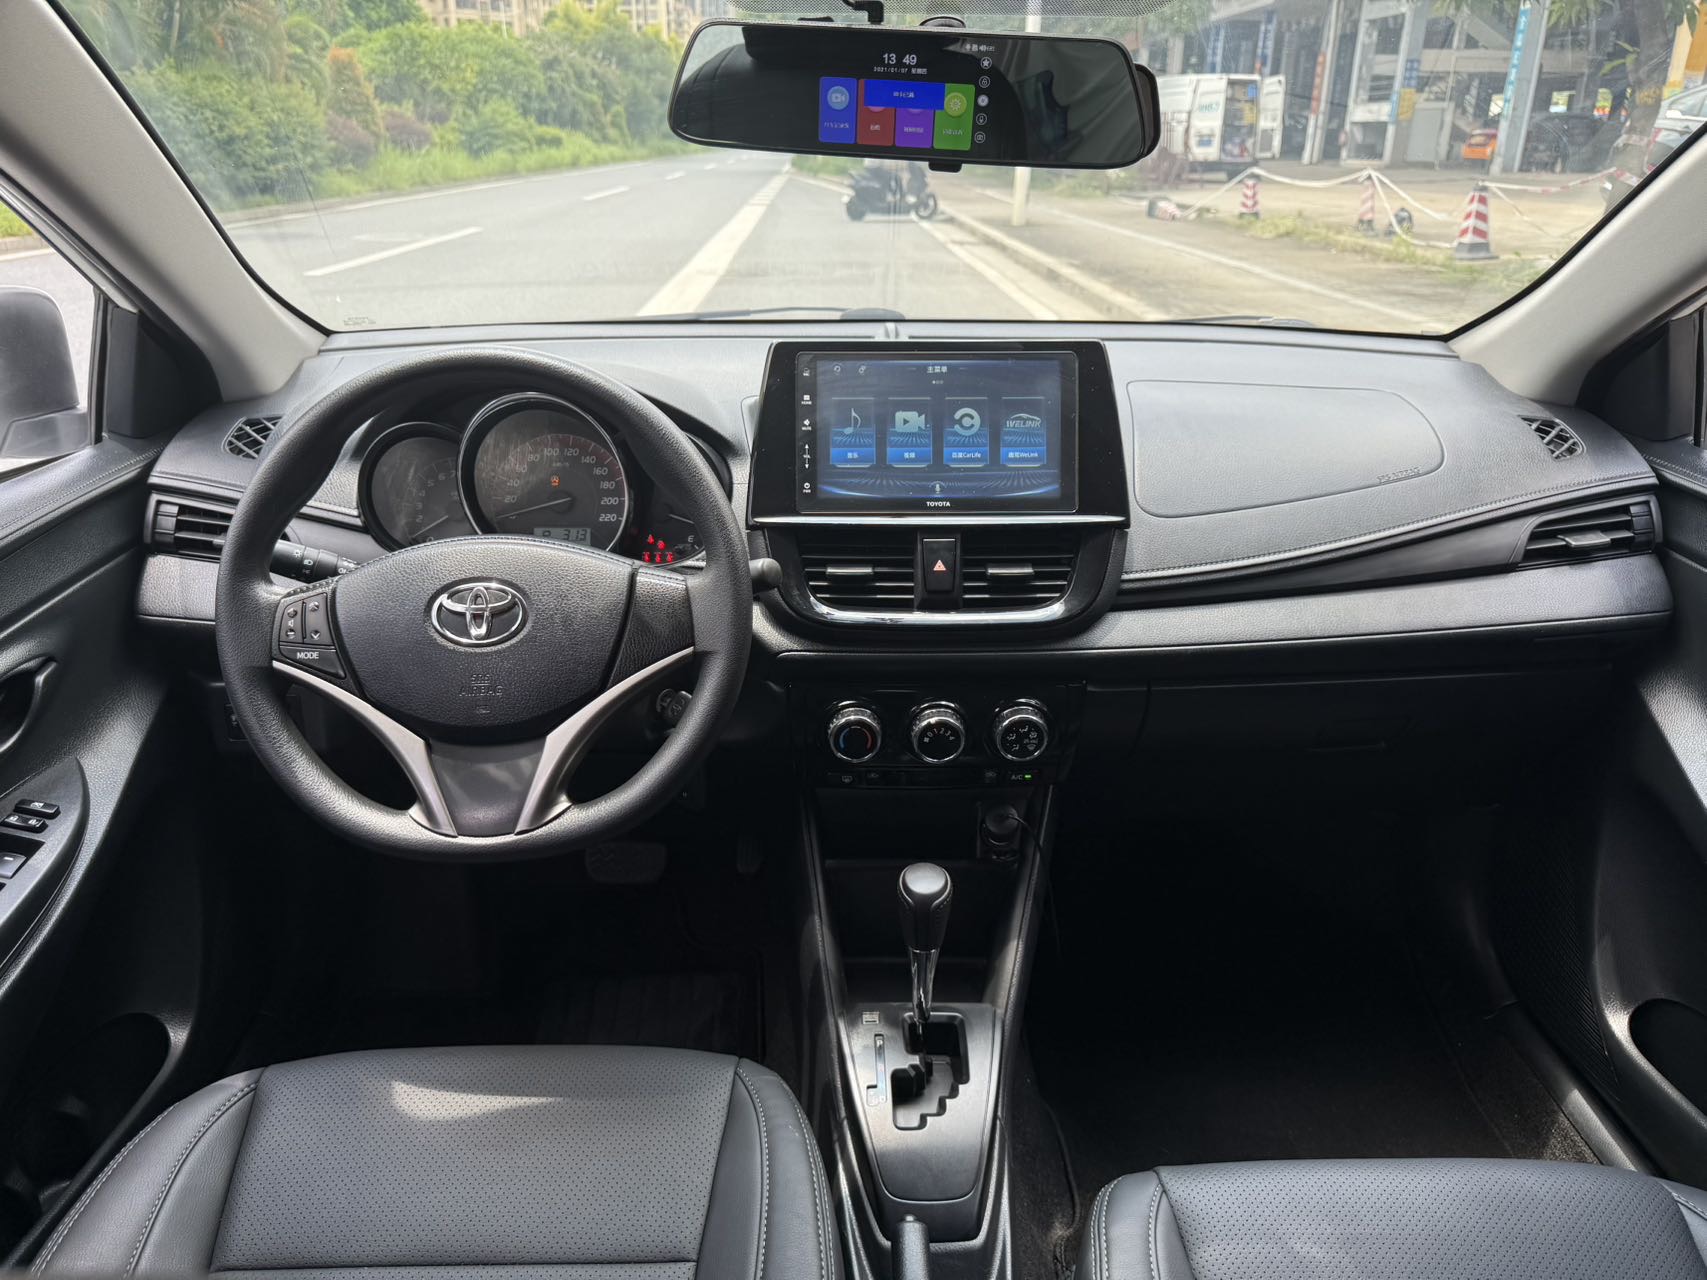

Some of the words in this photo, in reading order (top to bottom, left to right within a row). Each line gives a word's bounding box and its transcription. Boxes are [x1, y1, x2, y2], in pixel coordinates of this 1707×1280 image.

[882, 53, 896, 65] 13
[902, 54, 918, 65] 49
[1006, 420, 1041, 428] WELINK
[543, 448, 559, 456] 100
[563, 448, 579, 456] 120
[581, 455, 597, 464] 140
[593, 467, 608, 475] 160
[600, 481, 615, 489] 180
[600, 496, 619, 505] 200
[687, 535, 694, 543] E
[459, 685, 504, 697] AIRBAG
